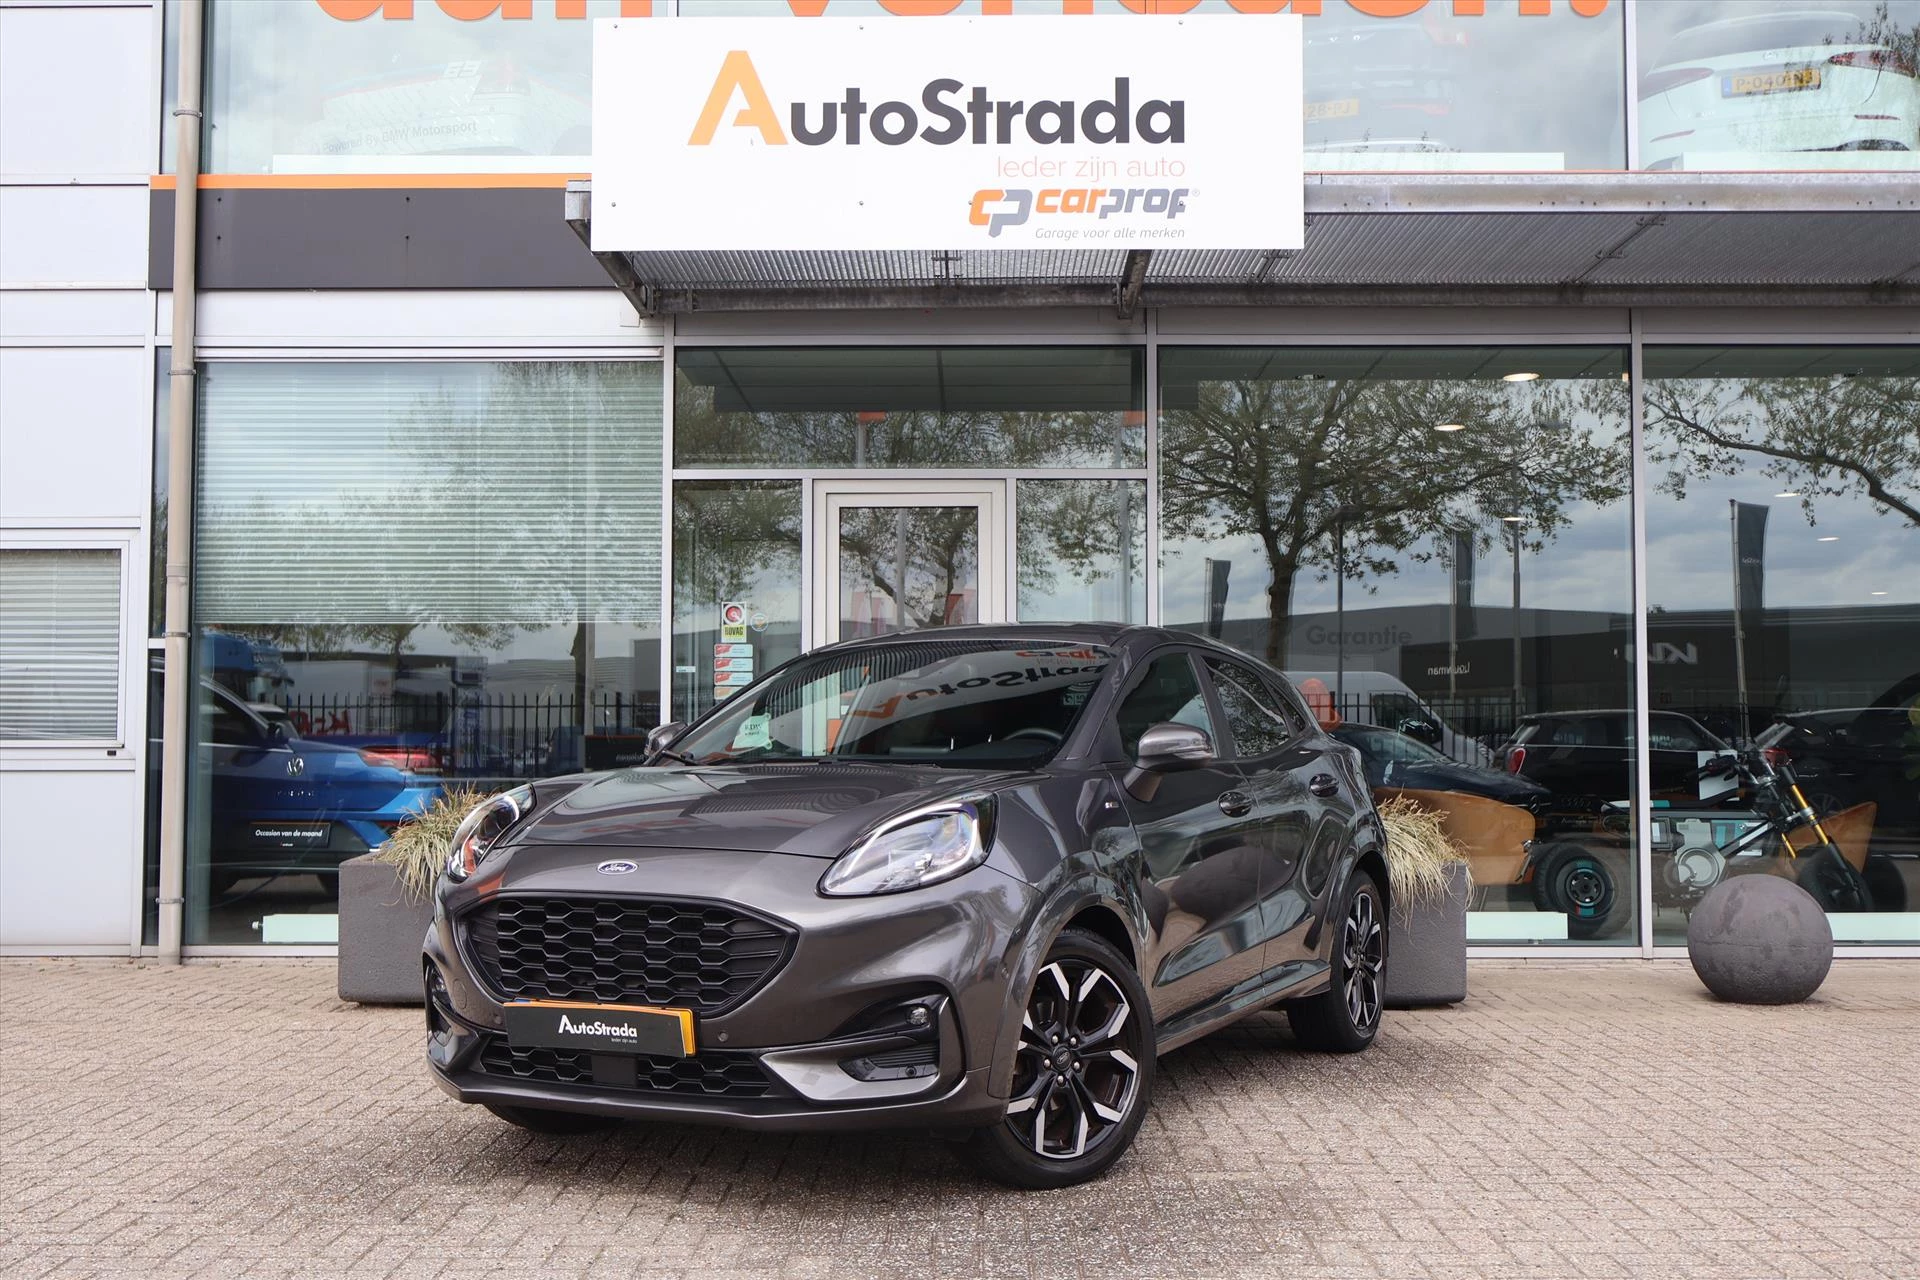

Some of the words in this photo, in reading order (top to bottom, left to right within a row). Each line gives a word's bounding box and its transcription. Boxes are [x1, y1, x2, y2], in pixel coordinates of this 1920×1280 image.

[687, 50, 1185, 146] AutoStrada
[366, 133, 380, 147] By
[382, 128, 410, 144] BMW
[412, 120, 478, 138] Motorsport
[1075, 156, 1117, 183] zijn
[1127, 157, 1186, 178] auto
[1035, 188, 1190, 220] carprof
[1035, 227, 1079, 241] Garage
[1083, 229, 1111, 239] voor
[1113, 227, 1137, 239] alle
[1139, 227, 1185, 239] merken
[1305, 624, 1413, 646] Garantie
[255, 829, 280, 837] Occasion
[293, 829, 300, 837] de
[301, 829, 323, 837] maand
[558, 1014, 638, 1038] AutoStrada
